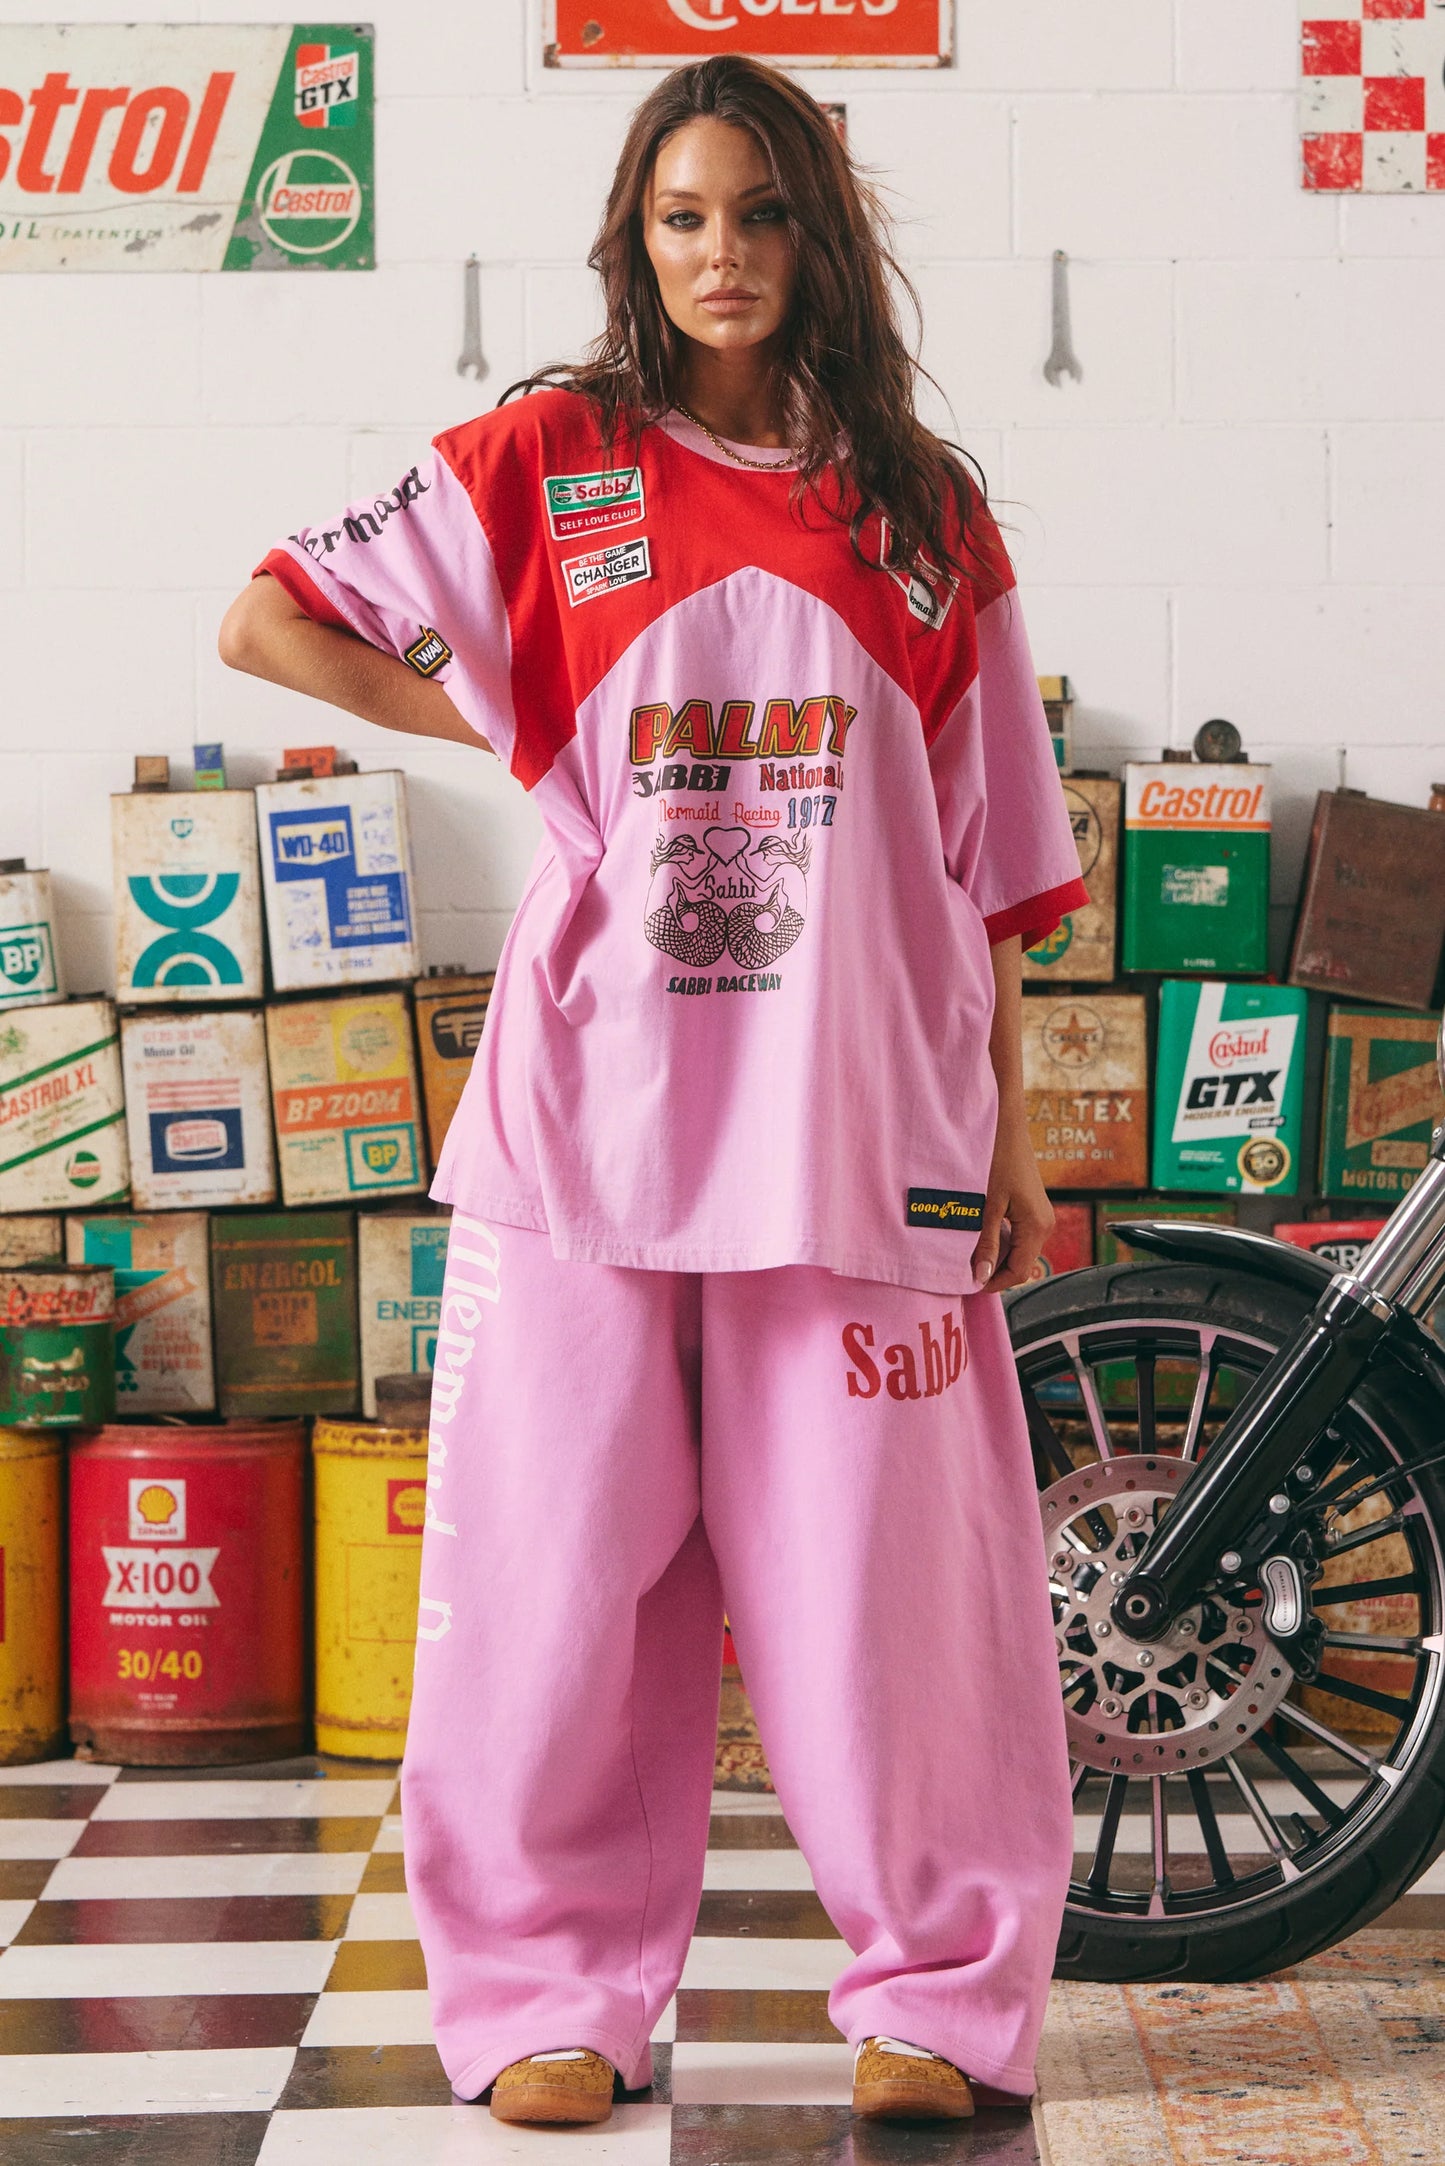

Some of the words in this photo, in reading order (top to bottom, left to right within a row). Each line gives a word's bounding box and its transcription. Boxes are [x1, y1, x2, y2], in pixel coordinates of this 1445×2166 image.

[301, 58, 355, 88] Castrol
[301, 77, 352, 111] GTX
[272, 187, 355, 214] Castrol
[575, 477, 632, 500] Sabbi
[559, 519, 583, 531] SELF
[585, 513, 609, 527] LOVE
[611, 508, 637, 521] CLUB
[573, 555, 640, 587] CHANGER
[578, 557, 588, 568] BE
[589, 554, 605, 565] THE
[605, 546, 627, 559] GAME
[586, 580, 608, 596] SPARK
[609, 575, 628, 587] LOVE
[629, 695, 857, 766] PALMY
[632, 764, 732, 798] SABBI
[732, 800, 783, 828] Racing
[787, 795, 838, 829] 1977
[1138, 780, 1264, 819] Castrol
[281, 832, 345, 859] WD-40
[697, 874, 757, 900] Sabbi
[2, 944, 41, 976] BP
[666, 976, 711, 996] SABBI
[716, 973, 783, 993] RACEWAY
[1208, 1028, 1270, 1069] Castrol
[74, 1062, 97, 1091] XL
[1186, 1070, 1281, 1110] GTX
[286, 1096, 324, 1124] BP
[326, 1087, 403, 1121] ZOOM
[1027, 1098, 1133, 1123] ALTEX
[1046, 1126, 1098, 1146] RPM
[367, 1144, 398, 1168] BP
[1341, 1168, 1398, 1190] MOTOR
[910, 1202, 939, 1213] GOOD
[948, 1202, 981, 1217] VIBES
[225, 1260, 341, 1290] ENERGOL
[7, 1285, 98, 1316] Castrol
[842, 1311, 968, 1401] Sabb
[116, 1561, 200, 1595] X-100
[109, 1612, 173, 1627] MOTOR
[178, 1613, 209, 1627] OIL
[117, 1648, 203, 1683] 30/40
